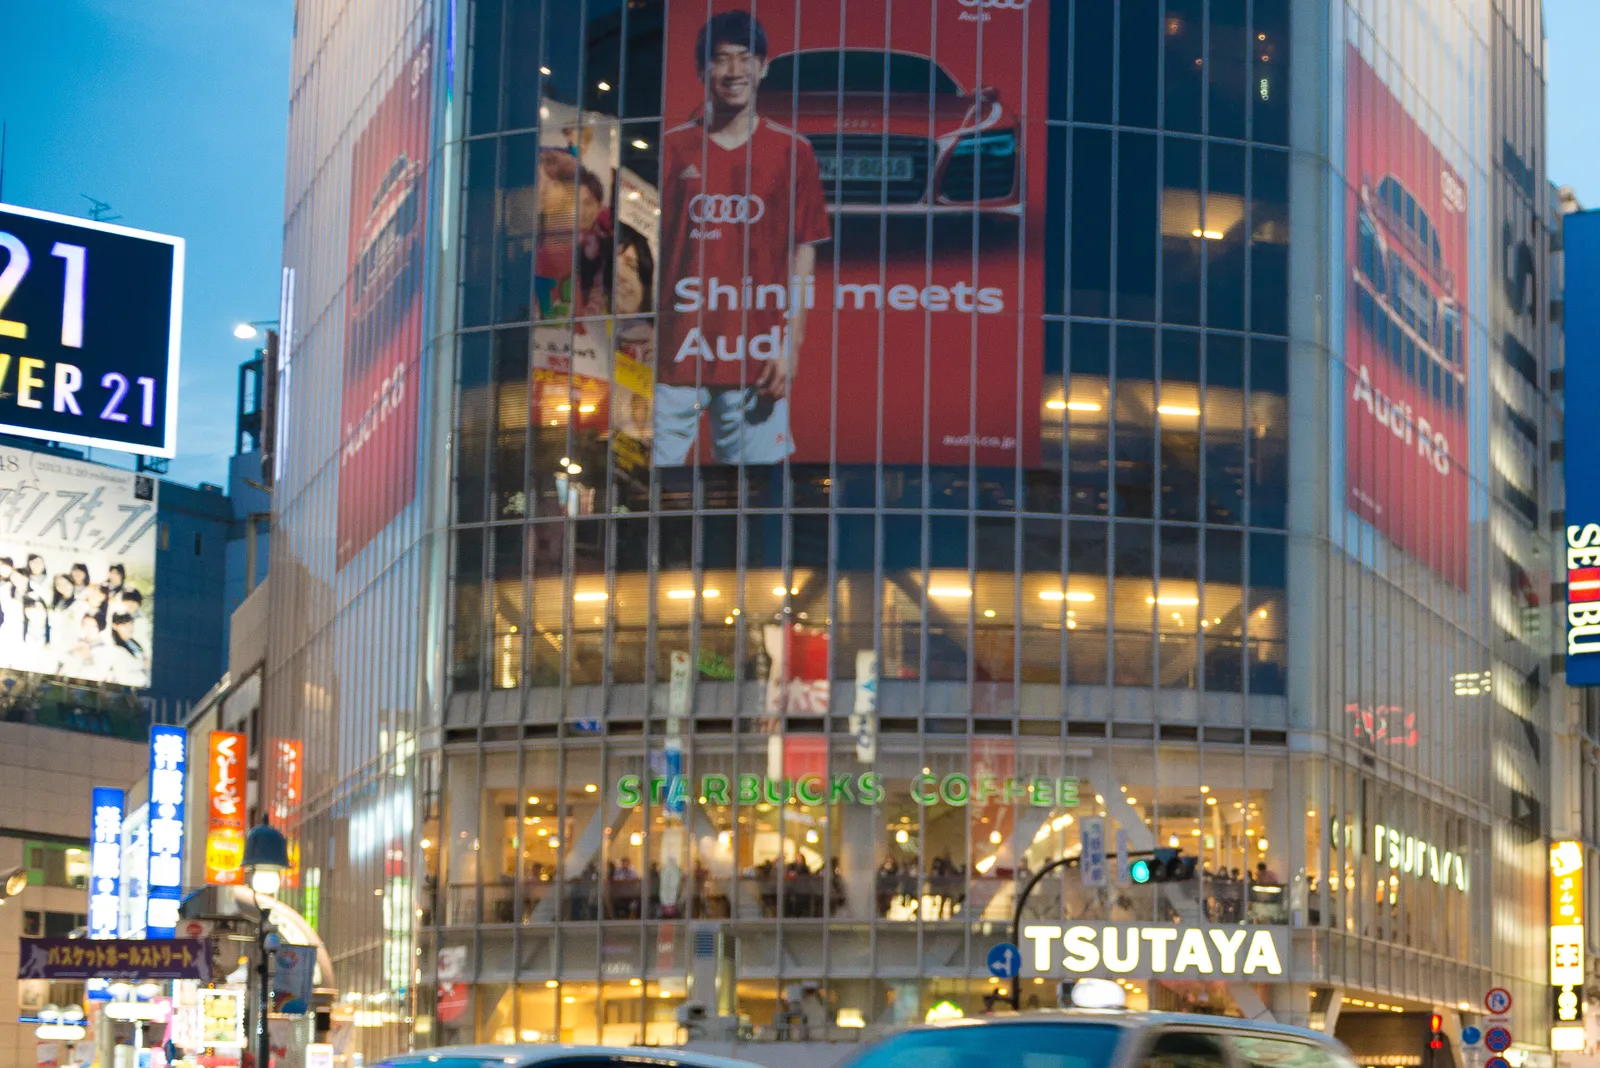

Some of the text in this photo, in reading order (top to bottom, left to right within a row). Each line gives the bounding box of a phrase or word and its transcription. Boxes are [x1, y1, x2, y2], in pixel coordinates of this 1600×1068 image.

[0, 231, 88, 349] 21
[674, 275, 1004, 319] Shinji meets
[674, 325, 790, 362] Audi
[100, 371, 156, 428] 21
[1353, 364, 1450, 476] Audi R8
[615, 771, 1081, 808] STARBUCKS COFFEE
[1374, 824, 1466, 892] TSUTAYA
[1024, 925, 1283, 975] TSUTAYA
